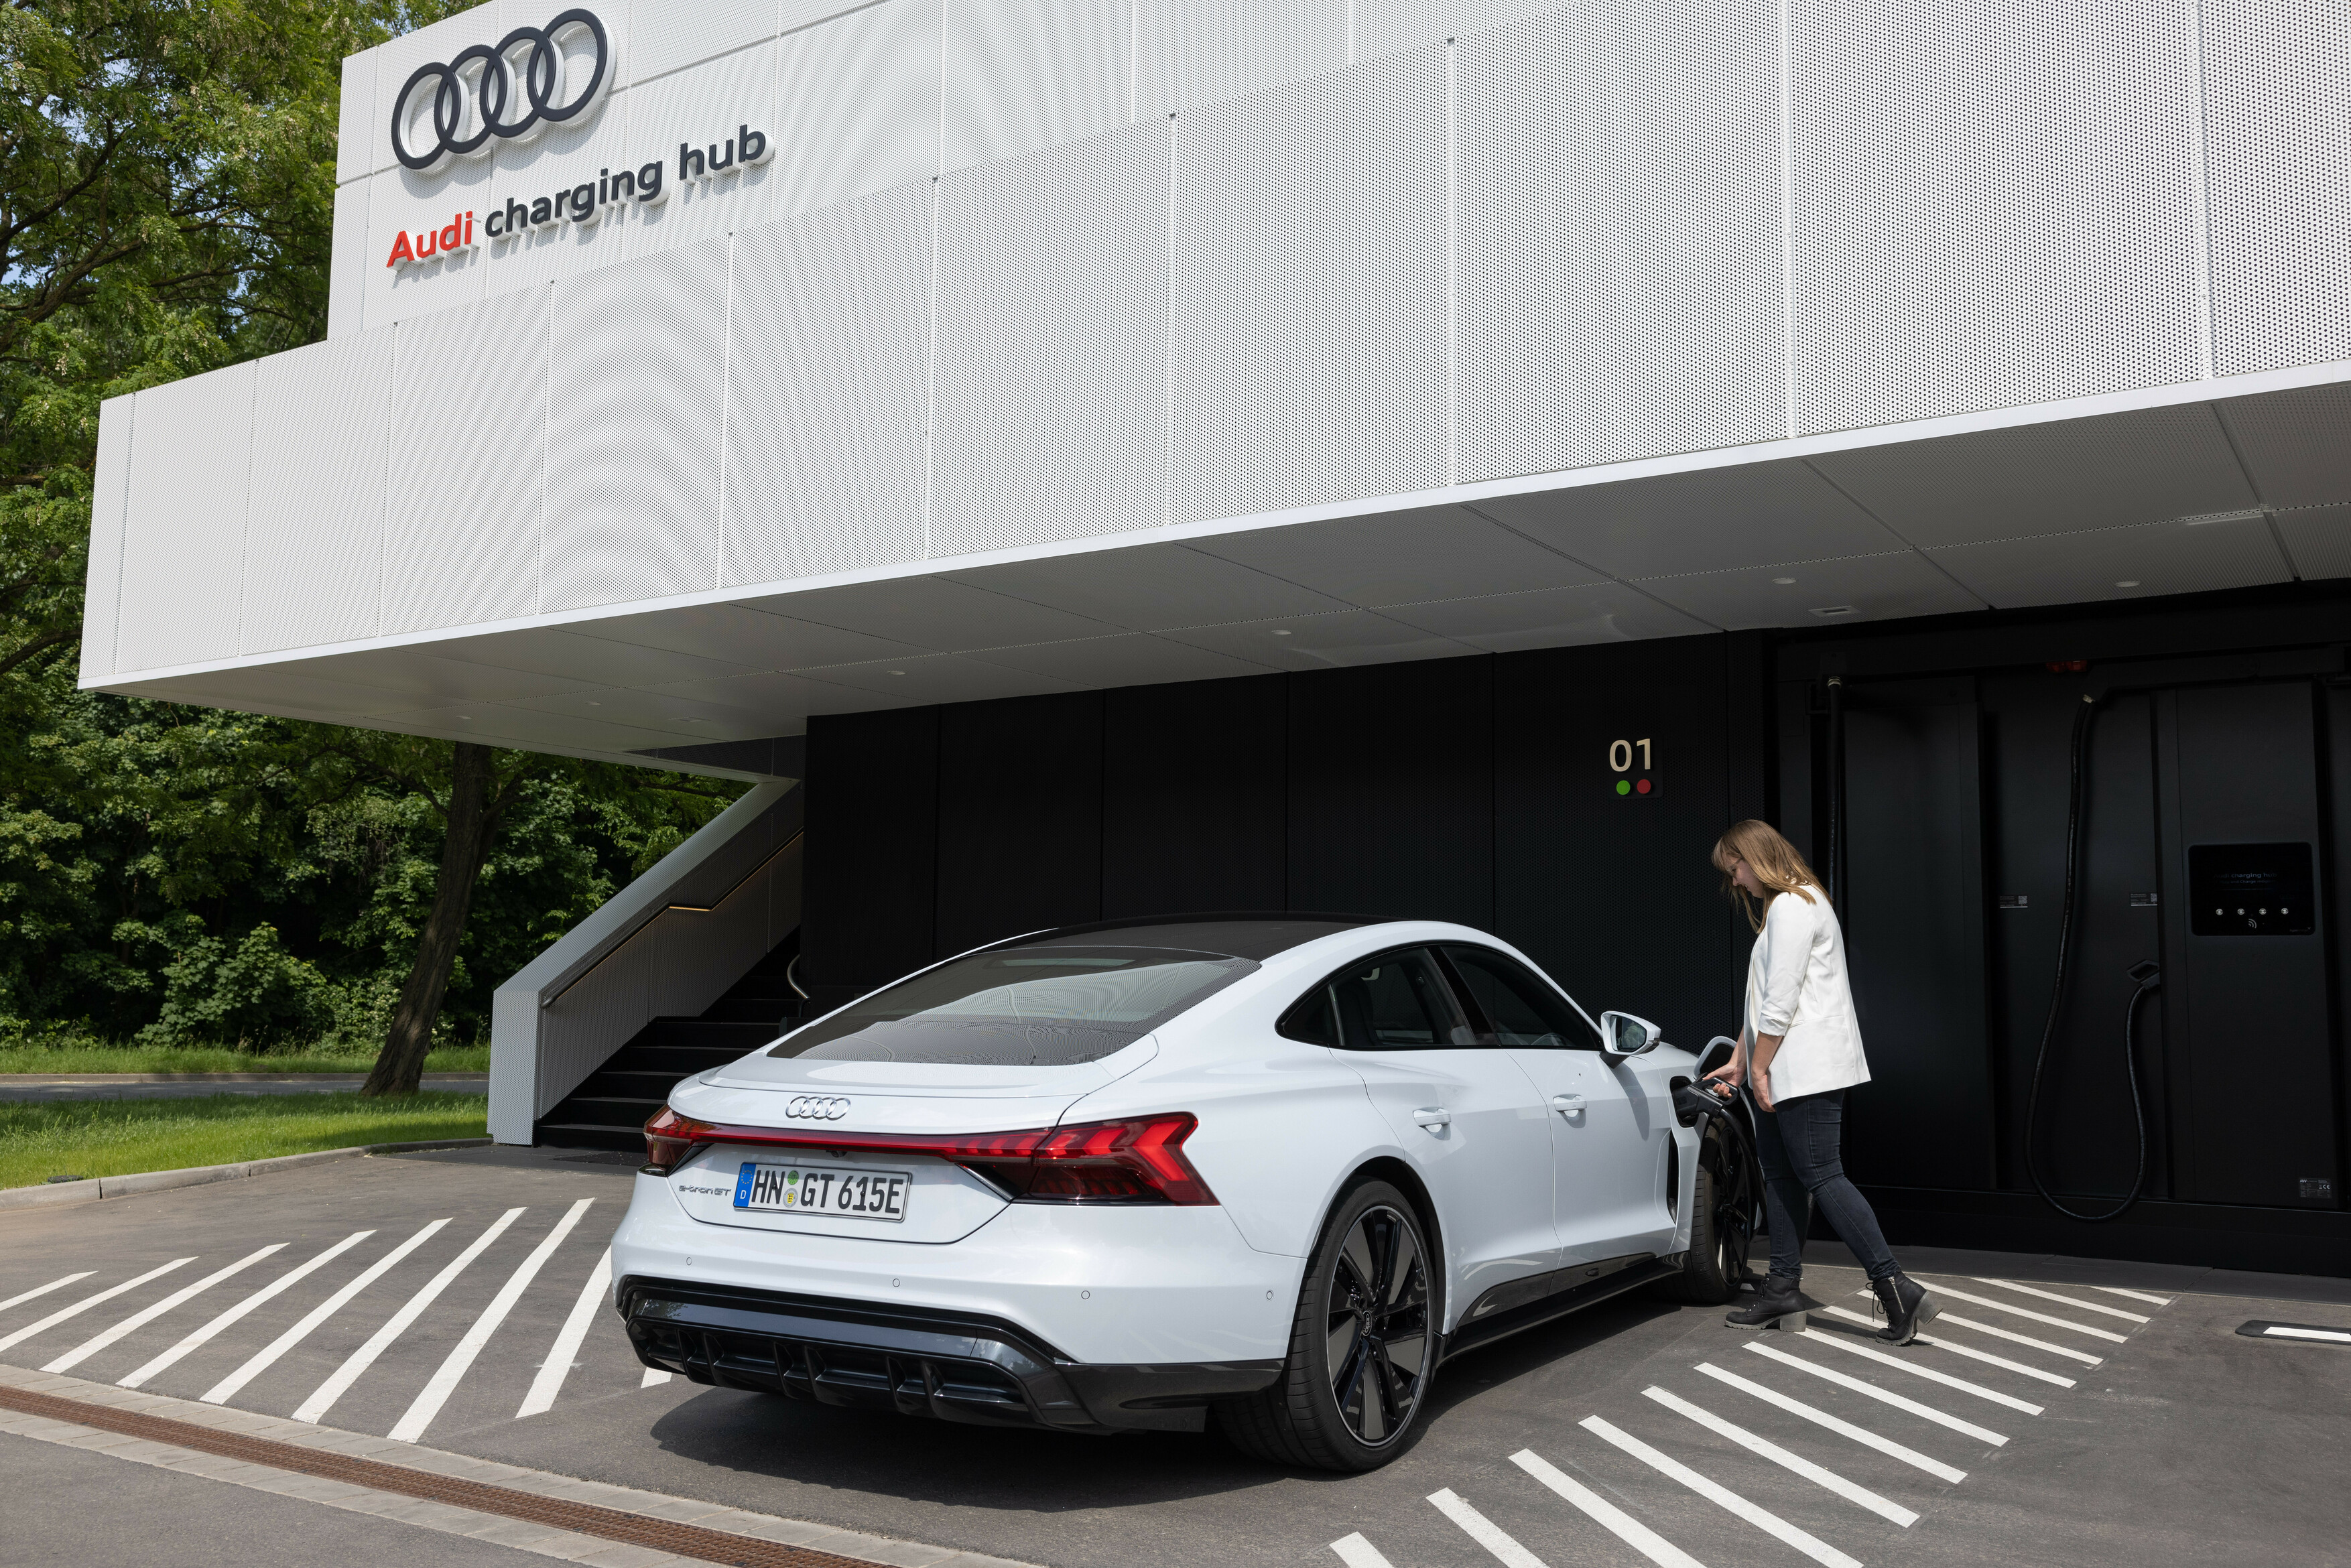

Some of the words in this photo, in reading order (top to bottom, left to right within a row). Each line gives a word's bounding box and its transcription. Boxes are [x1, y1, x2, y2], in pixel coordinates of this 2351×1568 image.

[386, 211, 473, 268] Audi
[485, 160, 663, 238] charging
[679, 125, 766, 181] hub
[1609, 738, 1651, 772] 01
[679, 1185, 713, 1195] e-tron
[714, 1187, 732, 1196] GT
[740, 1190, 747, 1199] D
[751, 1170, 785, 1204] HN
[800, 1173, 835, 1207] GT
[838, 1175, 904, 1214] 615E
